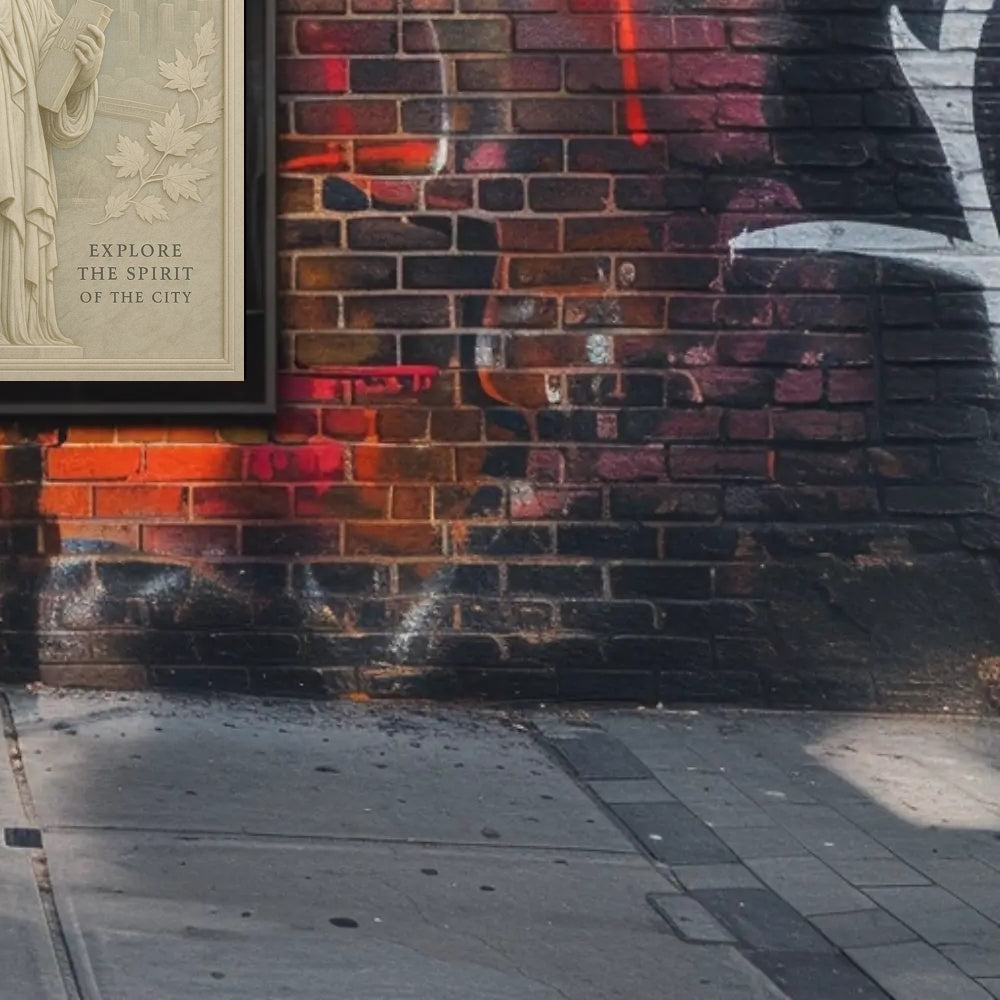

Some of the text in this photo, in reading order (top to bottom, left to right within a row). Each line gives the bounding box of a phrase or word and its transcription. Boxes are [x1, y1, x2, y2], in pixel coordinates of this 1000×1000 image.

[88, 243, 182, 258] EXPLORE
[77, 266, 195, 281] THE SPIRIT
[79, 291, 192, 304] OF THE CITY
